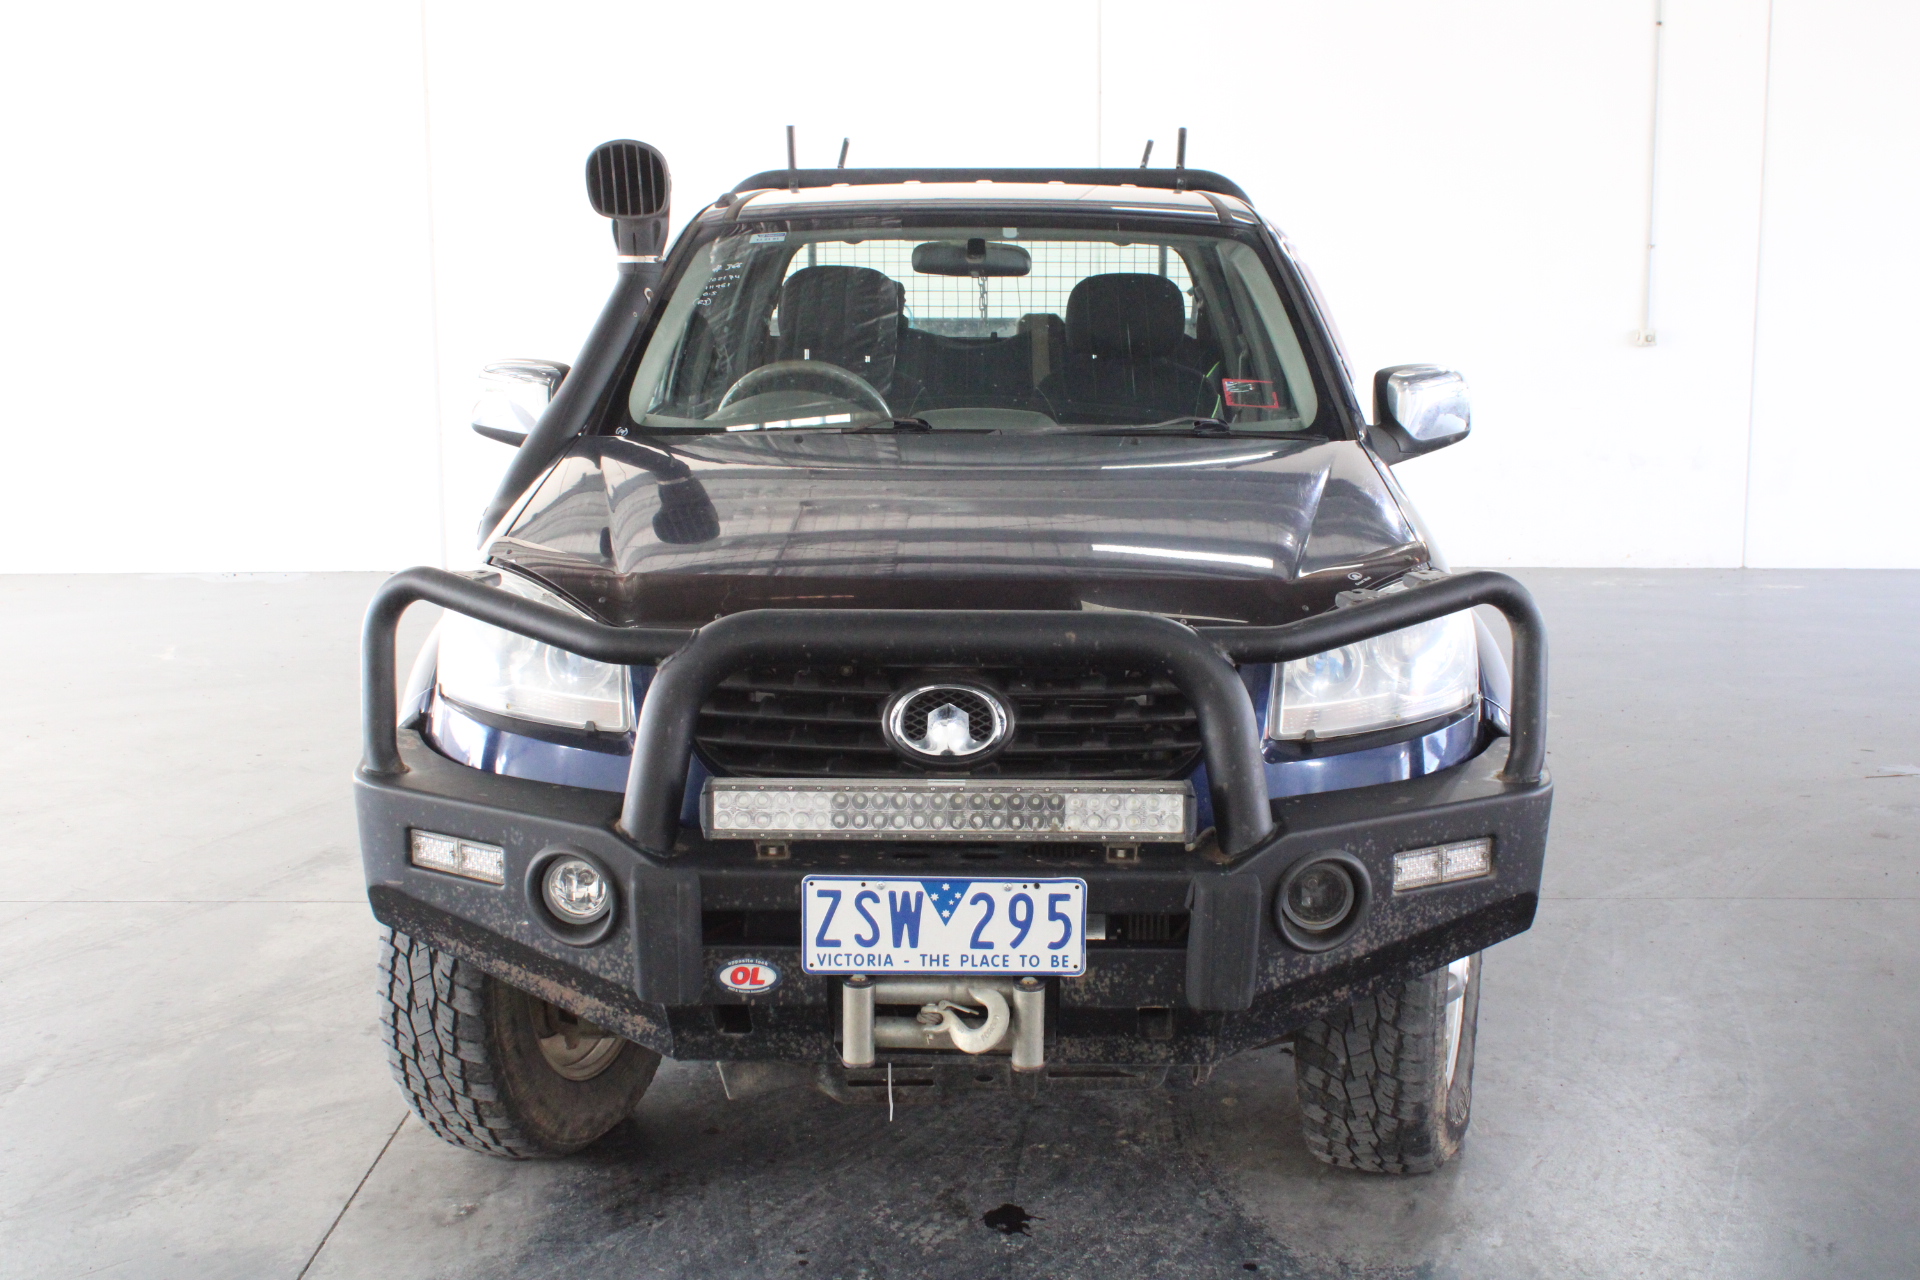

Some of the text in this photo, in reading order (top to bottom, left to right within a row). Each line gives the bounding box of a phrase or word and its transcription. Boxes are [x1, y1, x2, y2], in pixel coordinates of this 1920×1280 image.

[815, 889, 1073, 950] ZSW 295
[816, 953, 894, 967] VICTORIA
[920, 954, 950, 967] THE
[960, 954, 1009, 968] PLACE
[1020, 954, 1040, 968] TO
[1051, 954, 1069, 968] BE
[730, 966, 766, 985] OL
